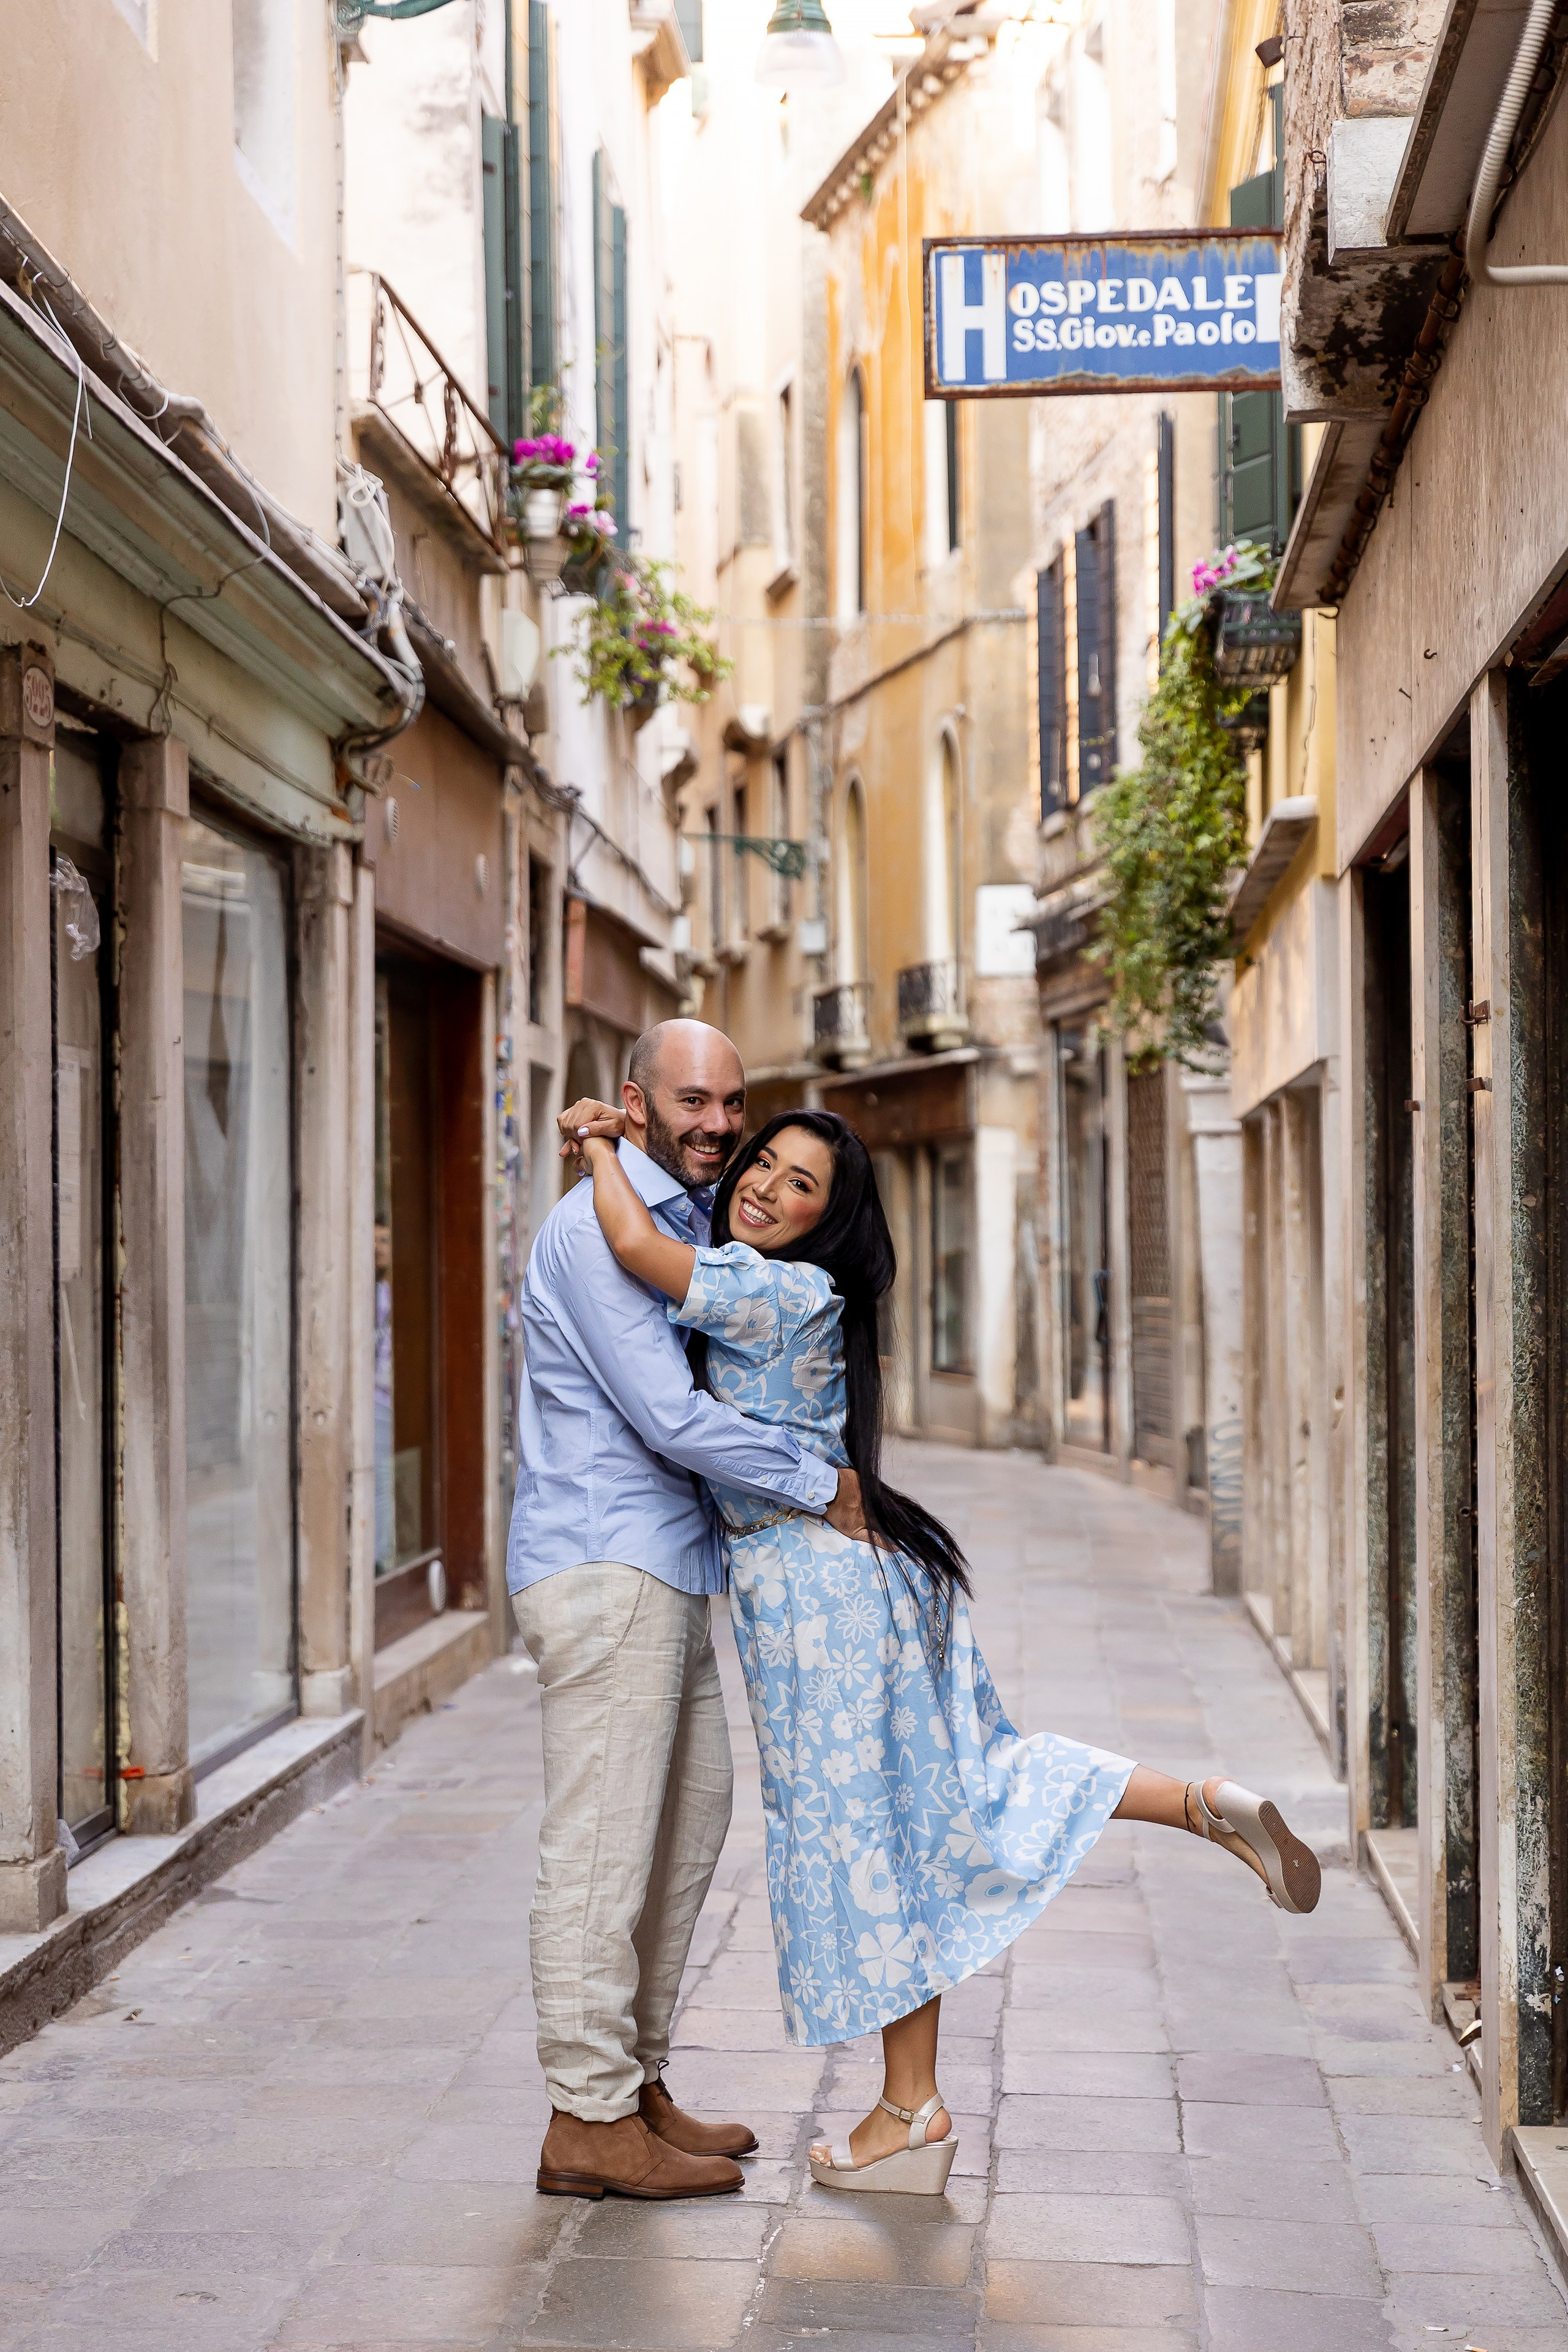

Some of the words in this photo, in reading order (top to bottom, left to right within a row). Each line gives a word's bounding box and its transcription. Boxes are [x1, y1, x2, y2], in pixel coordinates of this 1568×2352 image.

[1008, 274, 1254, 317] OSPEDALE
[941, 254, 1007, 382] H
[1153, 311, 1256, 347] Paolo
